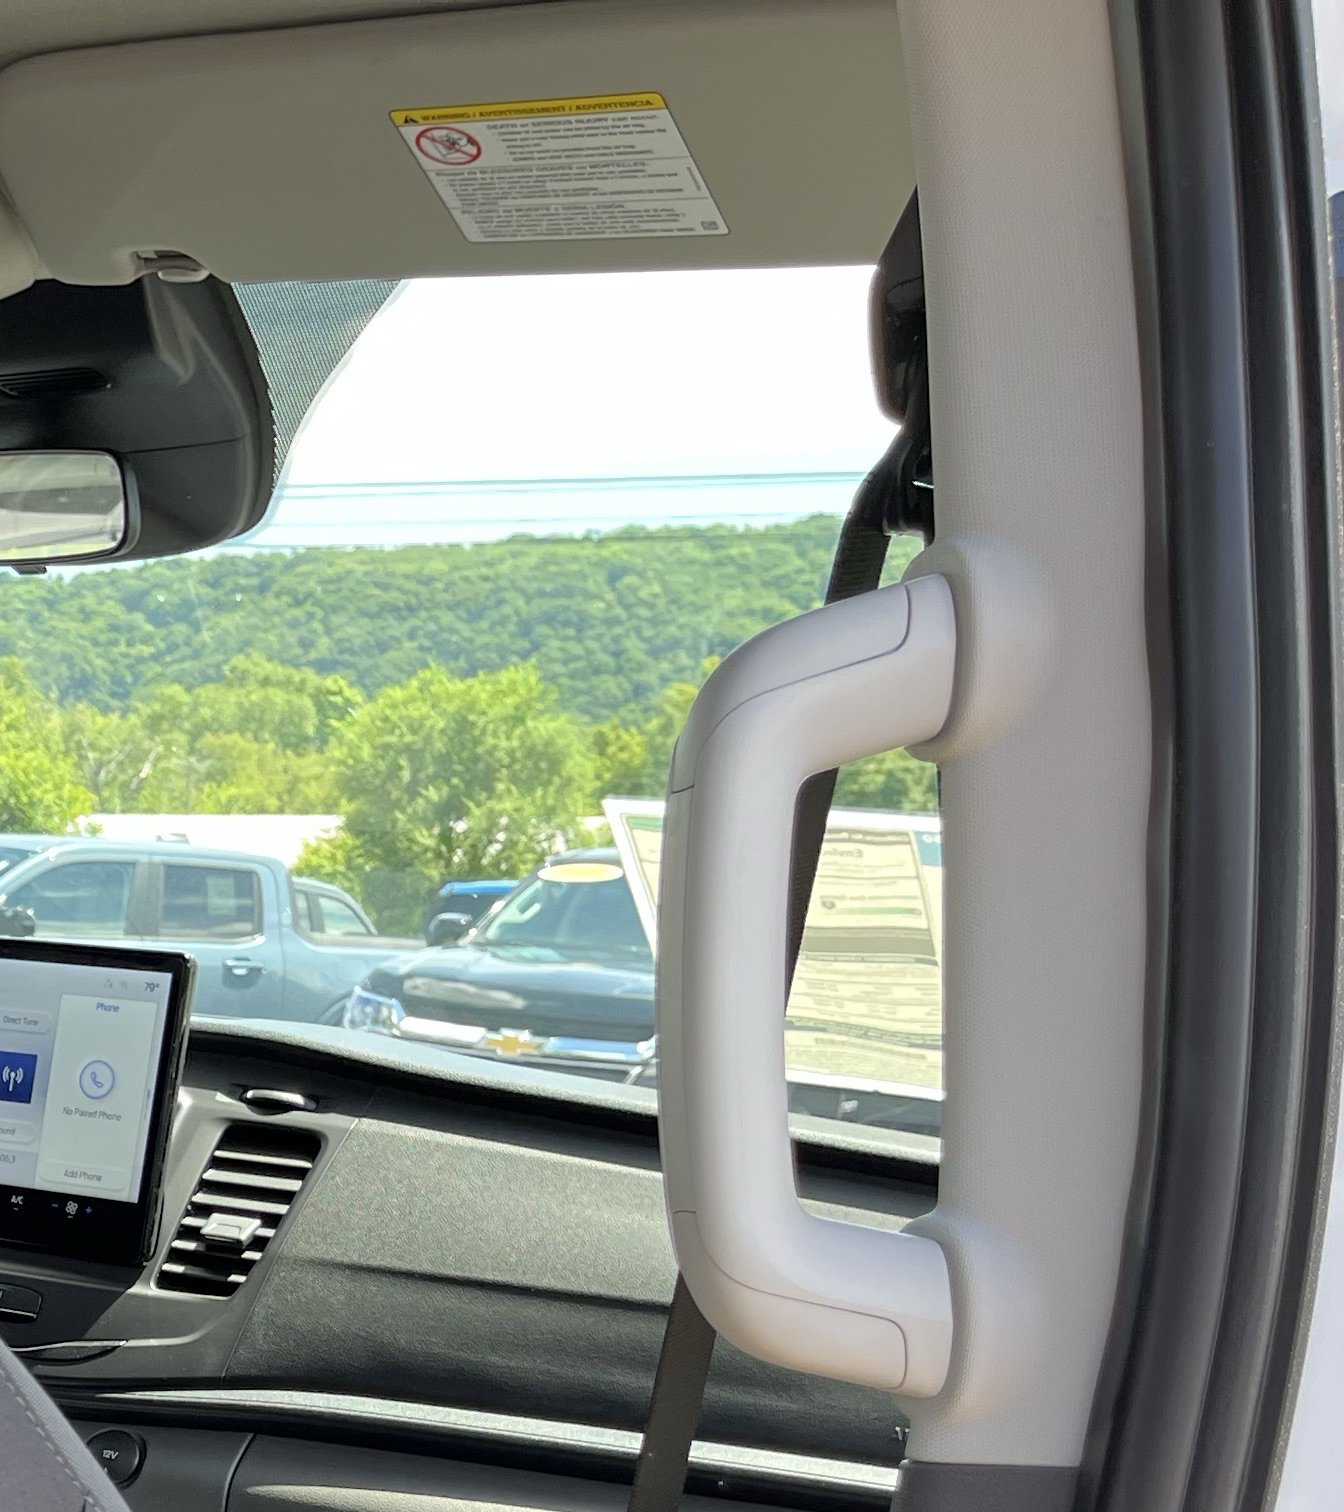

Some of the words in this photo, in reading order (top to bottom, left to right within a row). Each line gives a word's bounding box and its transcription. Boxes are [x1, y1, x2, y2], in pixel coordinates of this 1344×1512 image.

[96, 1001, 120, 1013] Phone
[3, 1015, 21, 1025] Direct
[23, 1017, 39, 1027] Tune
[63, 1106, 72, 1116] No
[74, 1108, 98, 1119] Paired
[99, 1110, 122, 1121] Phone
[64, 1168, 78, 1178] Add
[79, 1171, 102, 1182] Phone
[103, 1449, 119, 1460] 12V
